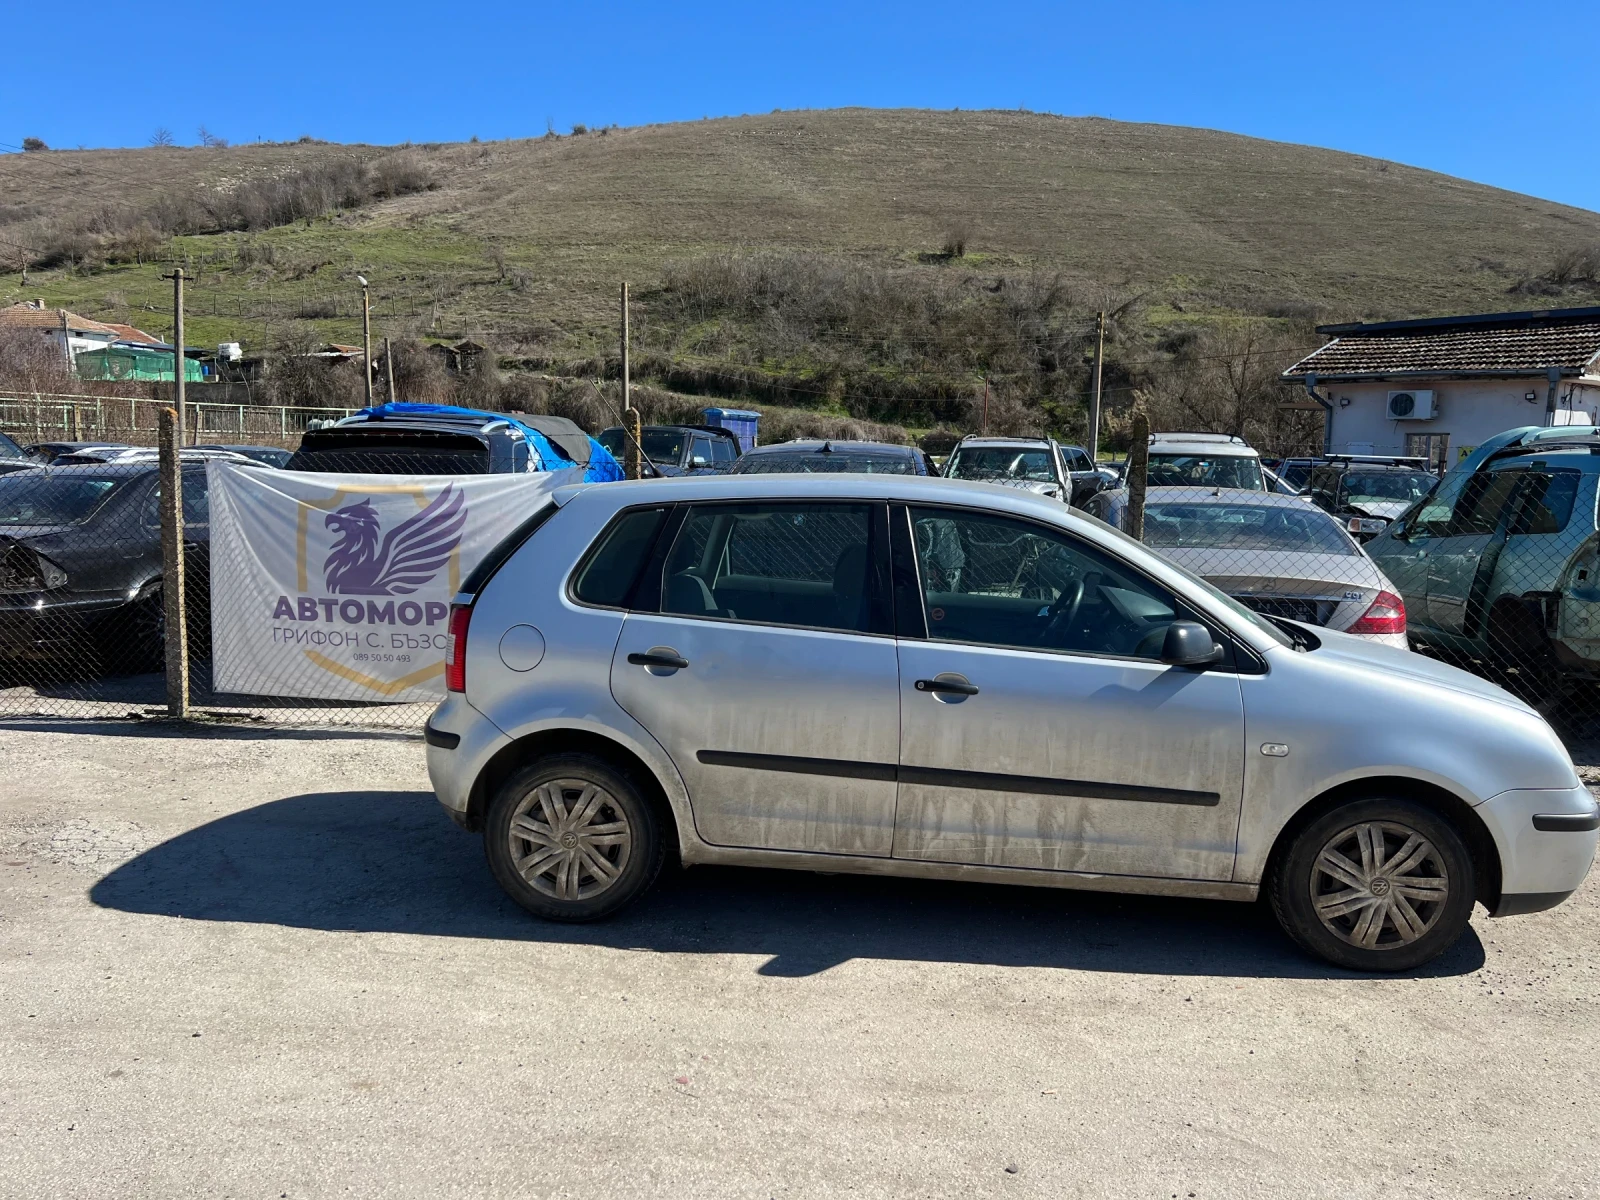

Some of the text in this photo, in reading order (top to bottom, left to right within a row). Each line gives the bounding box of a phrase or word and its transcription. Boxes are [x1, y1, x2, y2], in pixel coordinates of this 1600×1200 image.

[272, 595, 451, 626] АВТОМОР
[273, 627, 359, 647] ГРИФОН
[365, 632, 384, 648] С.
[353, 653, 411, 663] 089 50 50 493
